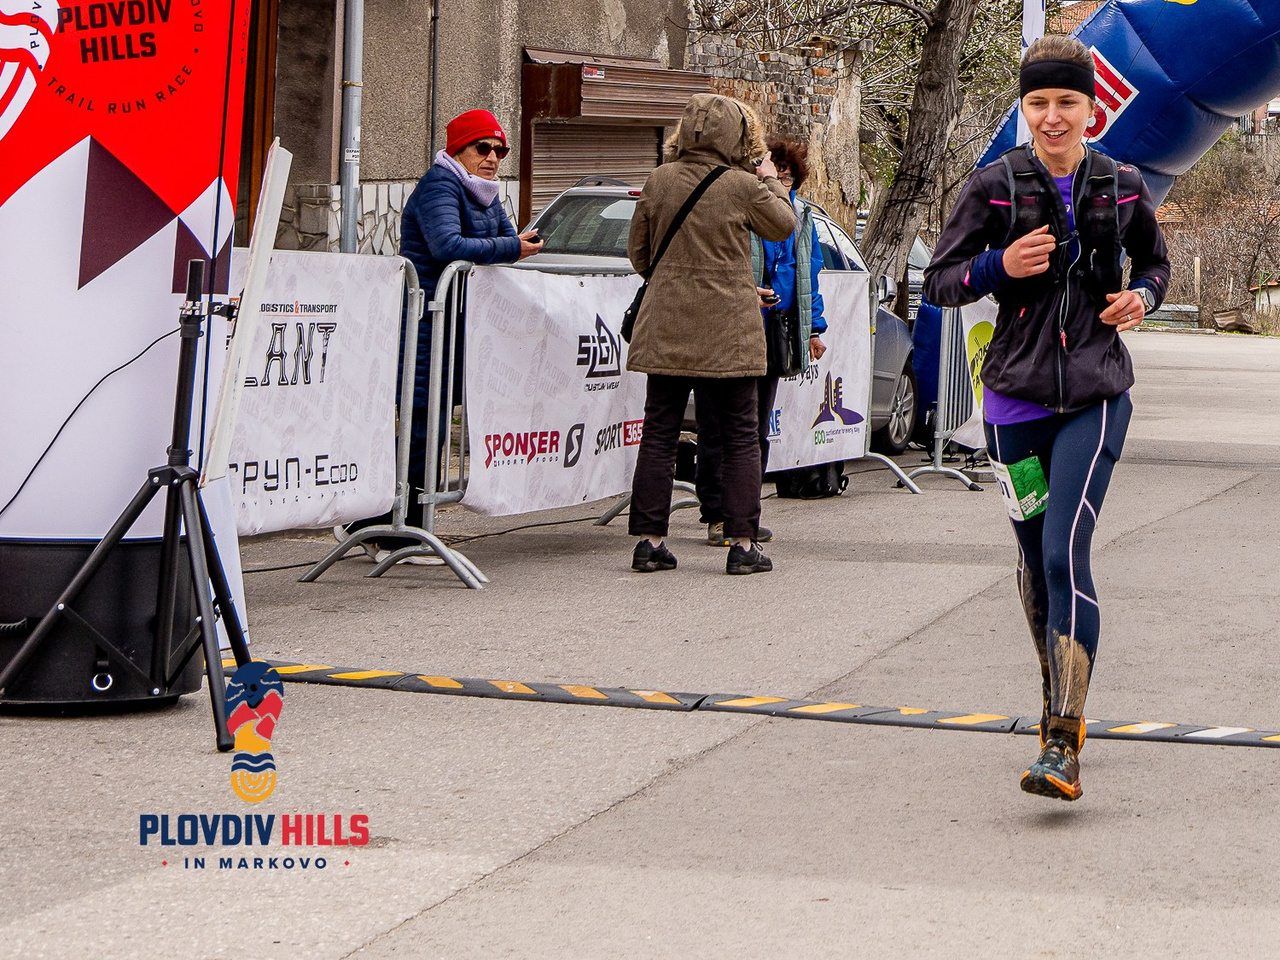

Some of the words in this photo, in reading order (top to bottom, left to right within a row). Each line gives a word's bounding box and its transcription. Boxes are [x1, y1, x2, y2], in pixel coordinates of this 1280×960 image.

[79, 32, 157, 64] HILLS
[47, 76, 95, 111] TRAIL
[108, 100, 146, 114] RUN
[155, 65, 192, 102] RACE
[485, 431, 560, 469] SPONSER
[594, 422, 623, 456] SPORT
[814, 430, 826, 445] ECO
